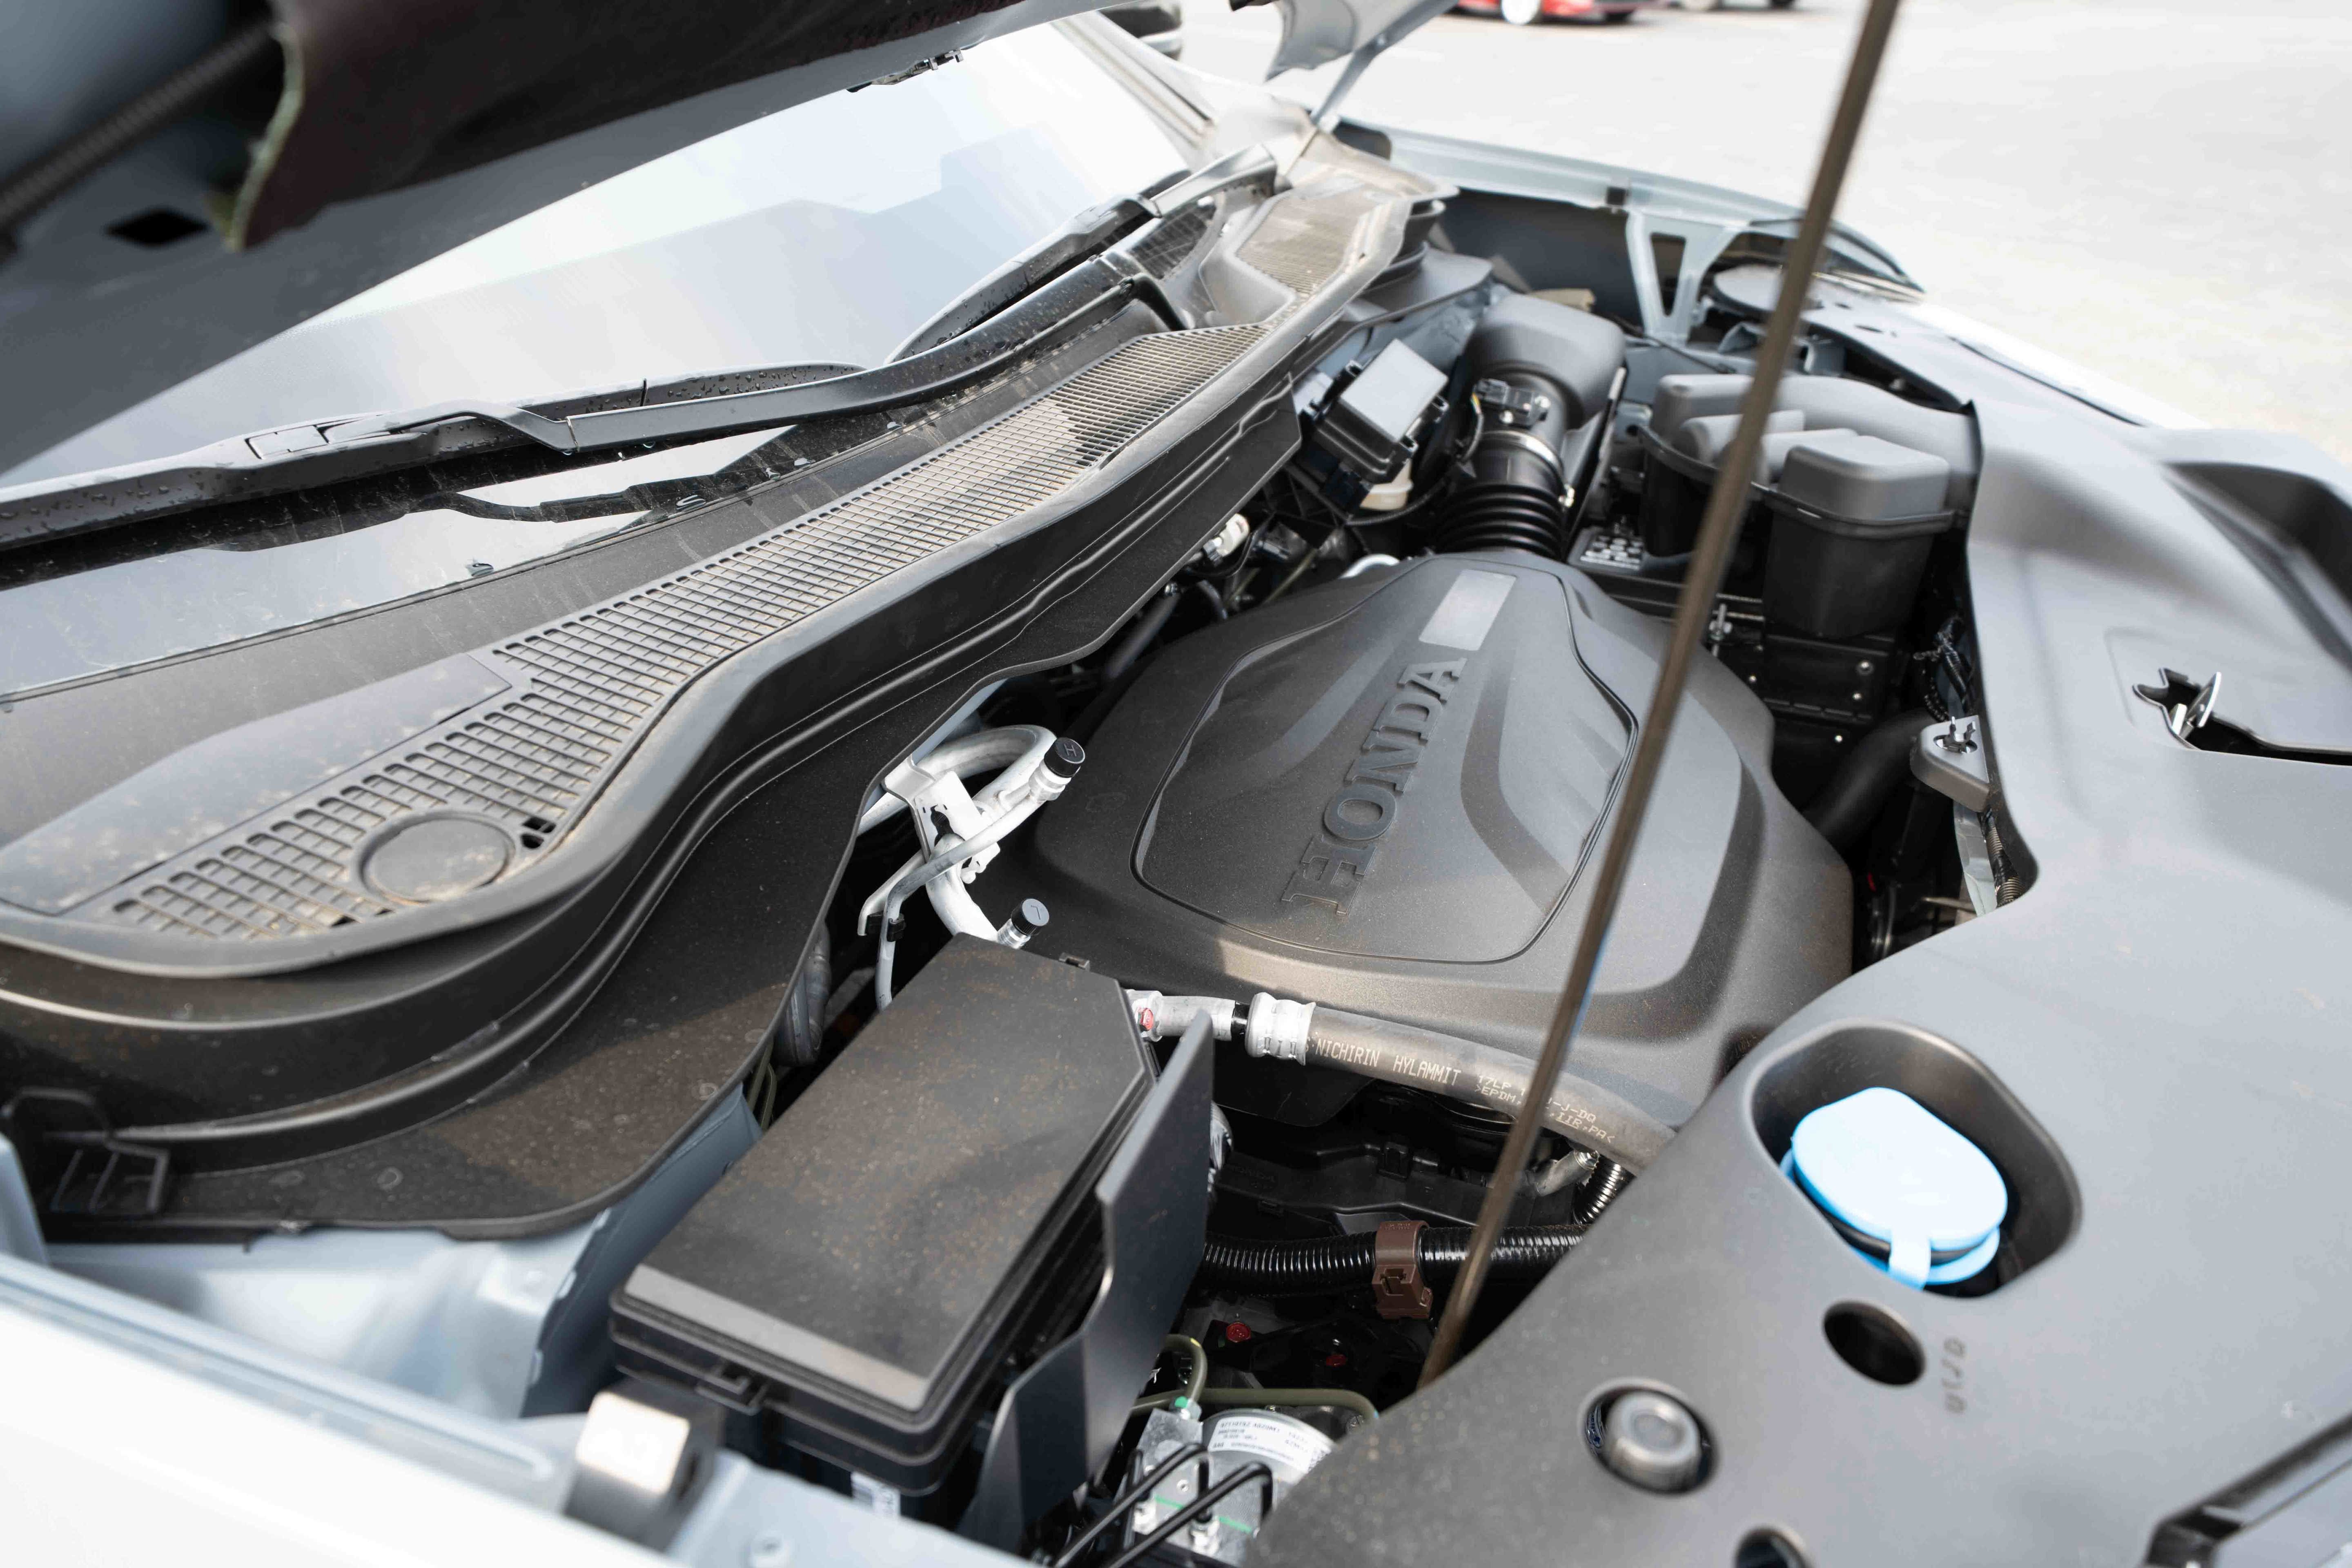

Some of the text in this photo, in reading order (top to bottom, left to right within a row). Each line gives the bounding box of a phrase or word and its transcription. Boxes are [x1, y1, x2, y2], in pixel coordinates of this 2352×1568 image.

[1064, 743, 1077, 757] H
[1281, 658, 1467, 915] HONDA
[1315, 1038, 1380, 1067] NICHIRIN
[1392, 1055, 1462, 1086] HYLAMMIT
[1479, 1076, 1512, 1090] 17LP
